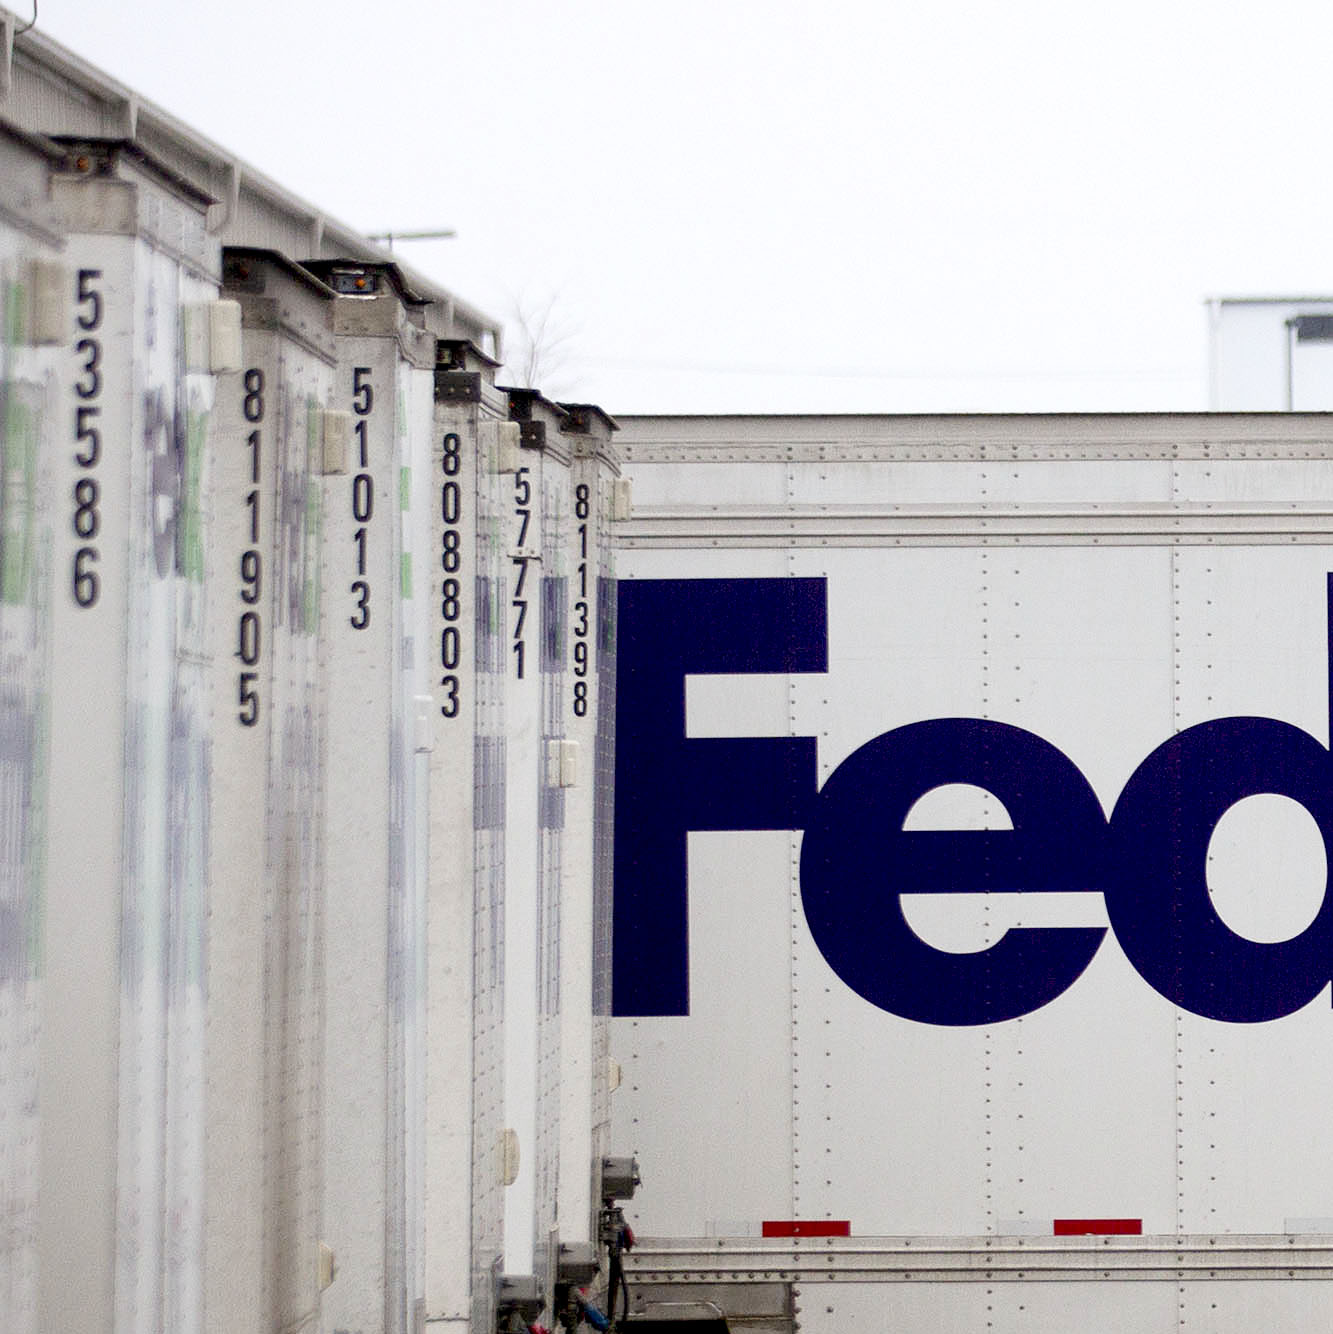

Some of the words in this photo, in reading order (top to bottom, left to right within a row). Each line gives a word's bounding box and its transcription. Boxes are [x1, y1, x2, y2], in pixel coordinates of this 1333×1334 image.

[71, 267, 103, 609] 53586
[237, 367, 267, 728] 811905
[350, 366, 374, 631] 51013
[440, 432, 461, 719] 808803
[511, 467, 531, 680] 57771
[573, 483, 590, 718] 811398
